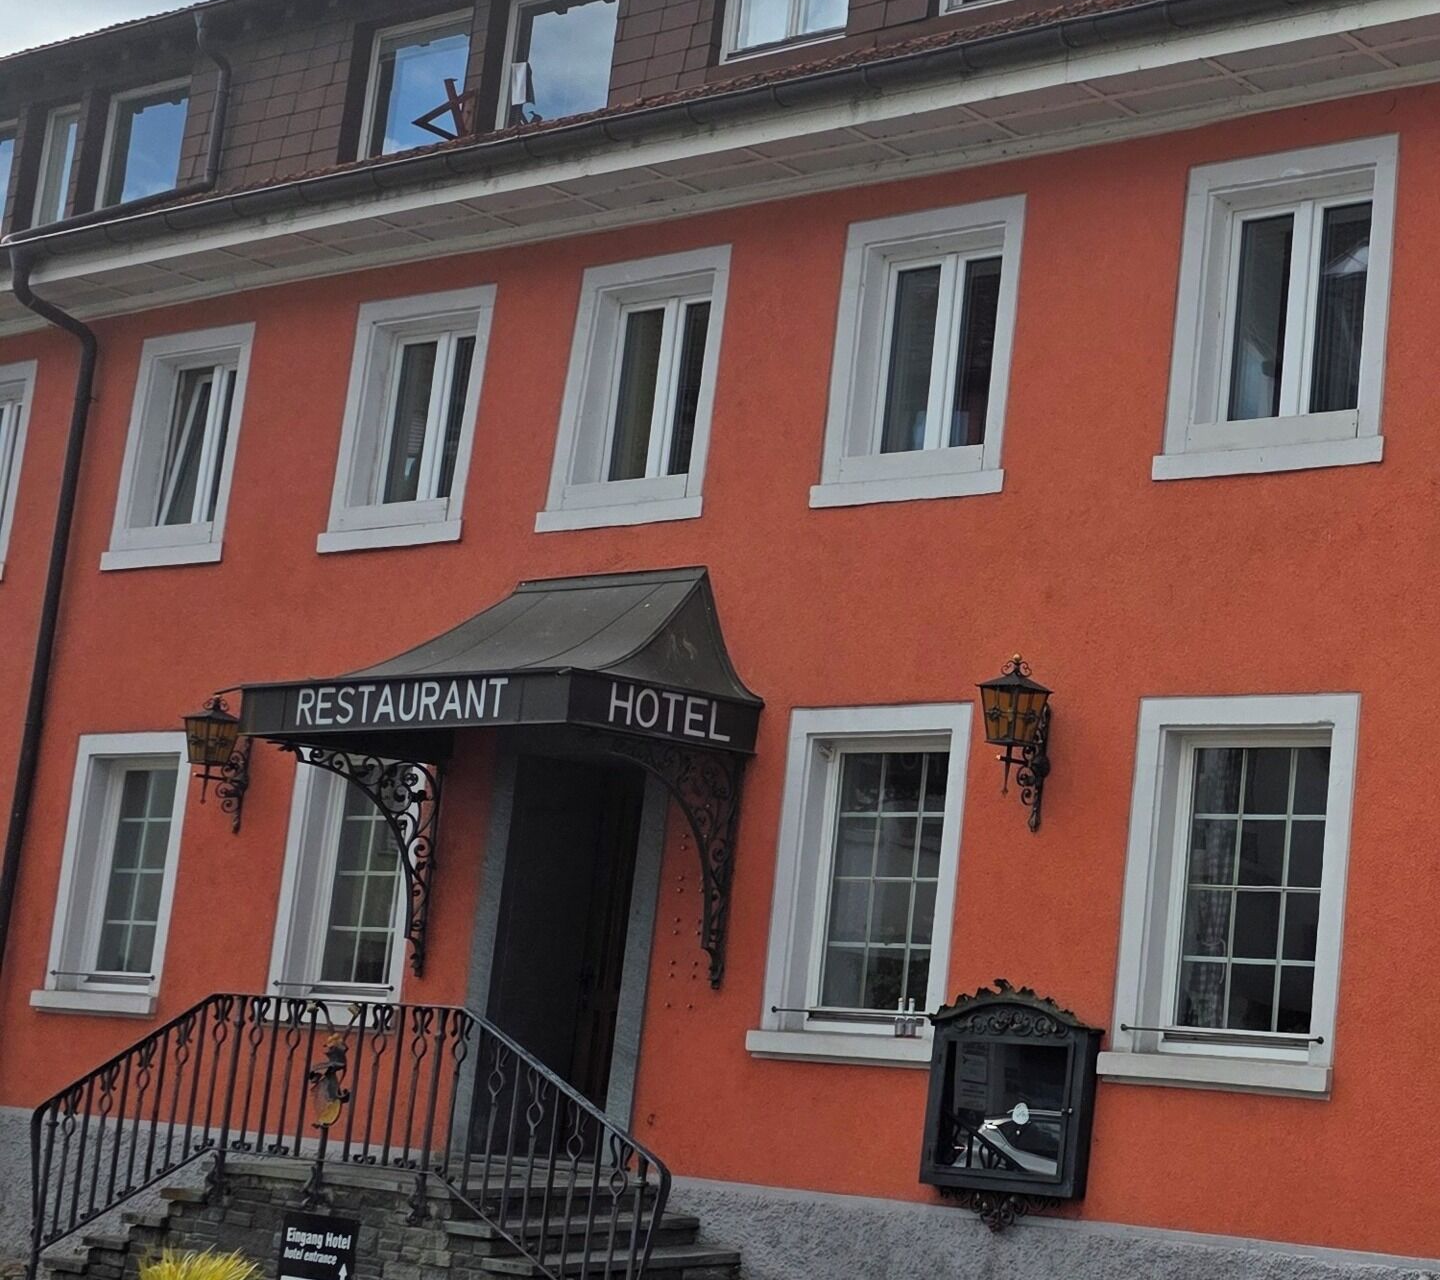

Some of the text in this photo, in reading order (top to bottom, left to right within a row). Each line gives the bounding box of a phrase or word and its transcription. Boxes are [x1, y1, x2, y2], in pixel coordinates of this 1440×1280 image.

[295, 677, 508, 726] RESTAURANT
[608, 681, 731, 743] HOTEL
[283, 1246, 338, 1265] hotel entrance
[285, 1226, 352, 1250] Eingang Hotel
